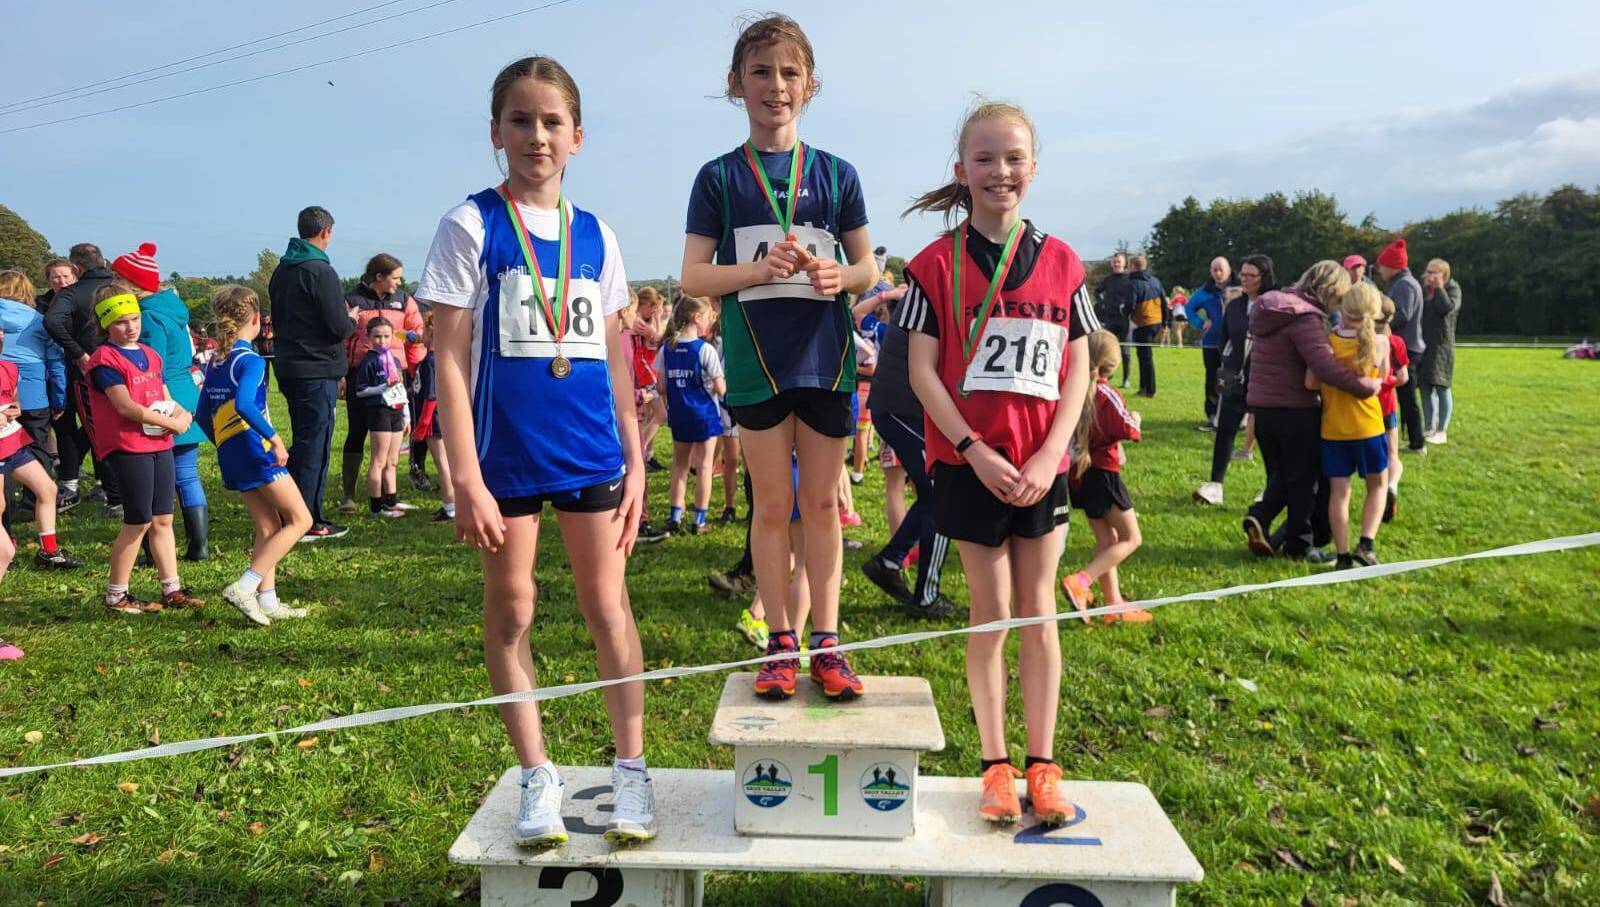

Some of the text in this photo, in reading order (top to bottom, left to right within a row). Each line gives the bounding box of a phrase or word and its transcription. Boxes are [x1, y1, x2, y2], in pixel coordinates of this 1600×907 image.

[983, 334, 1050, 377] 216
[808, 754, 838, 816] 1
[1013, 796, 1103, 846] 2
